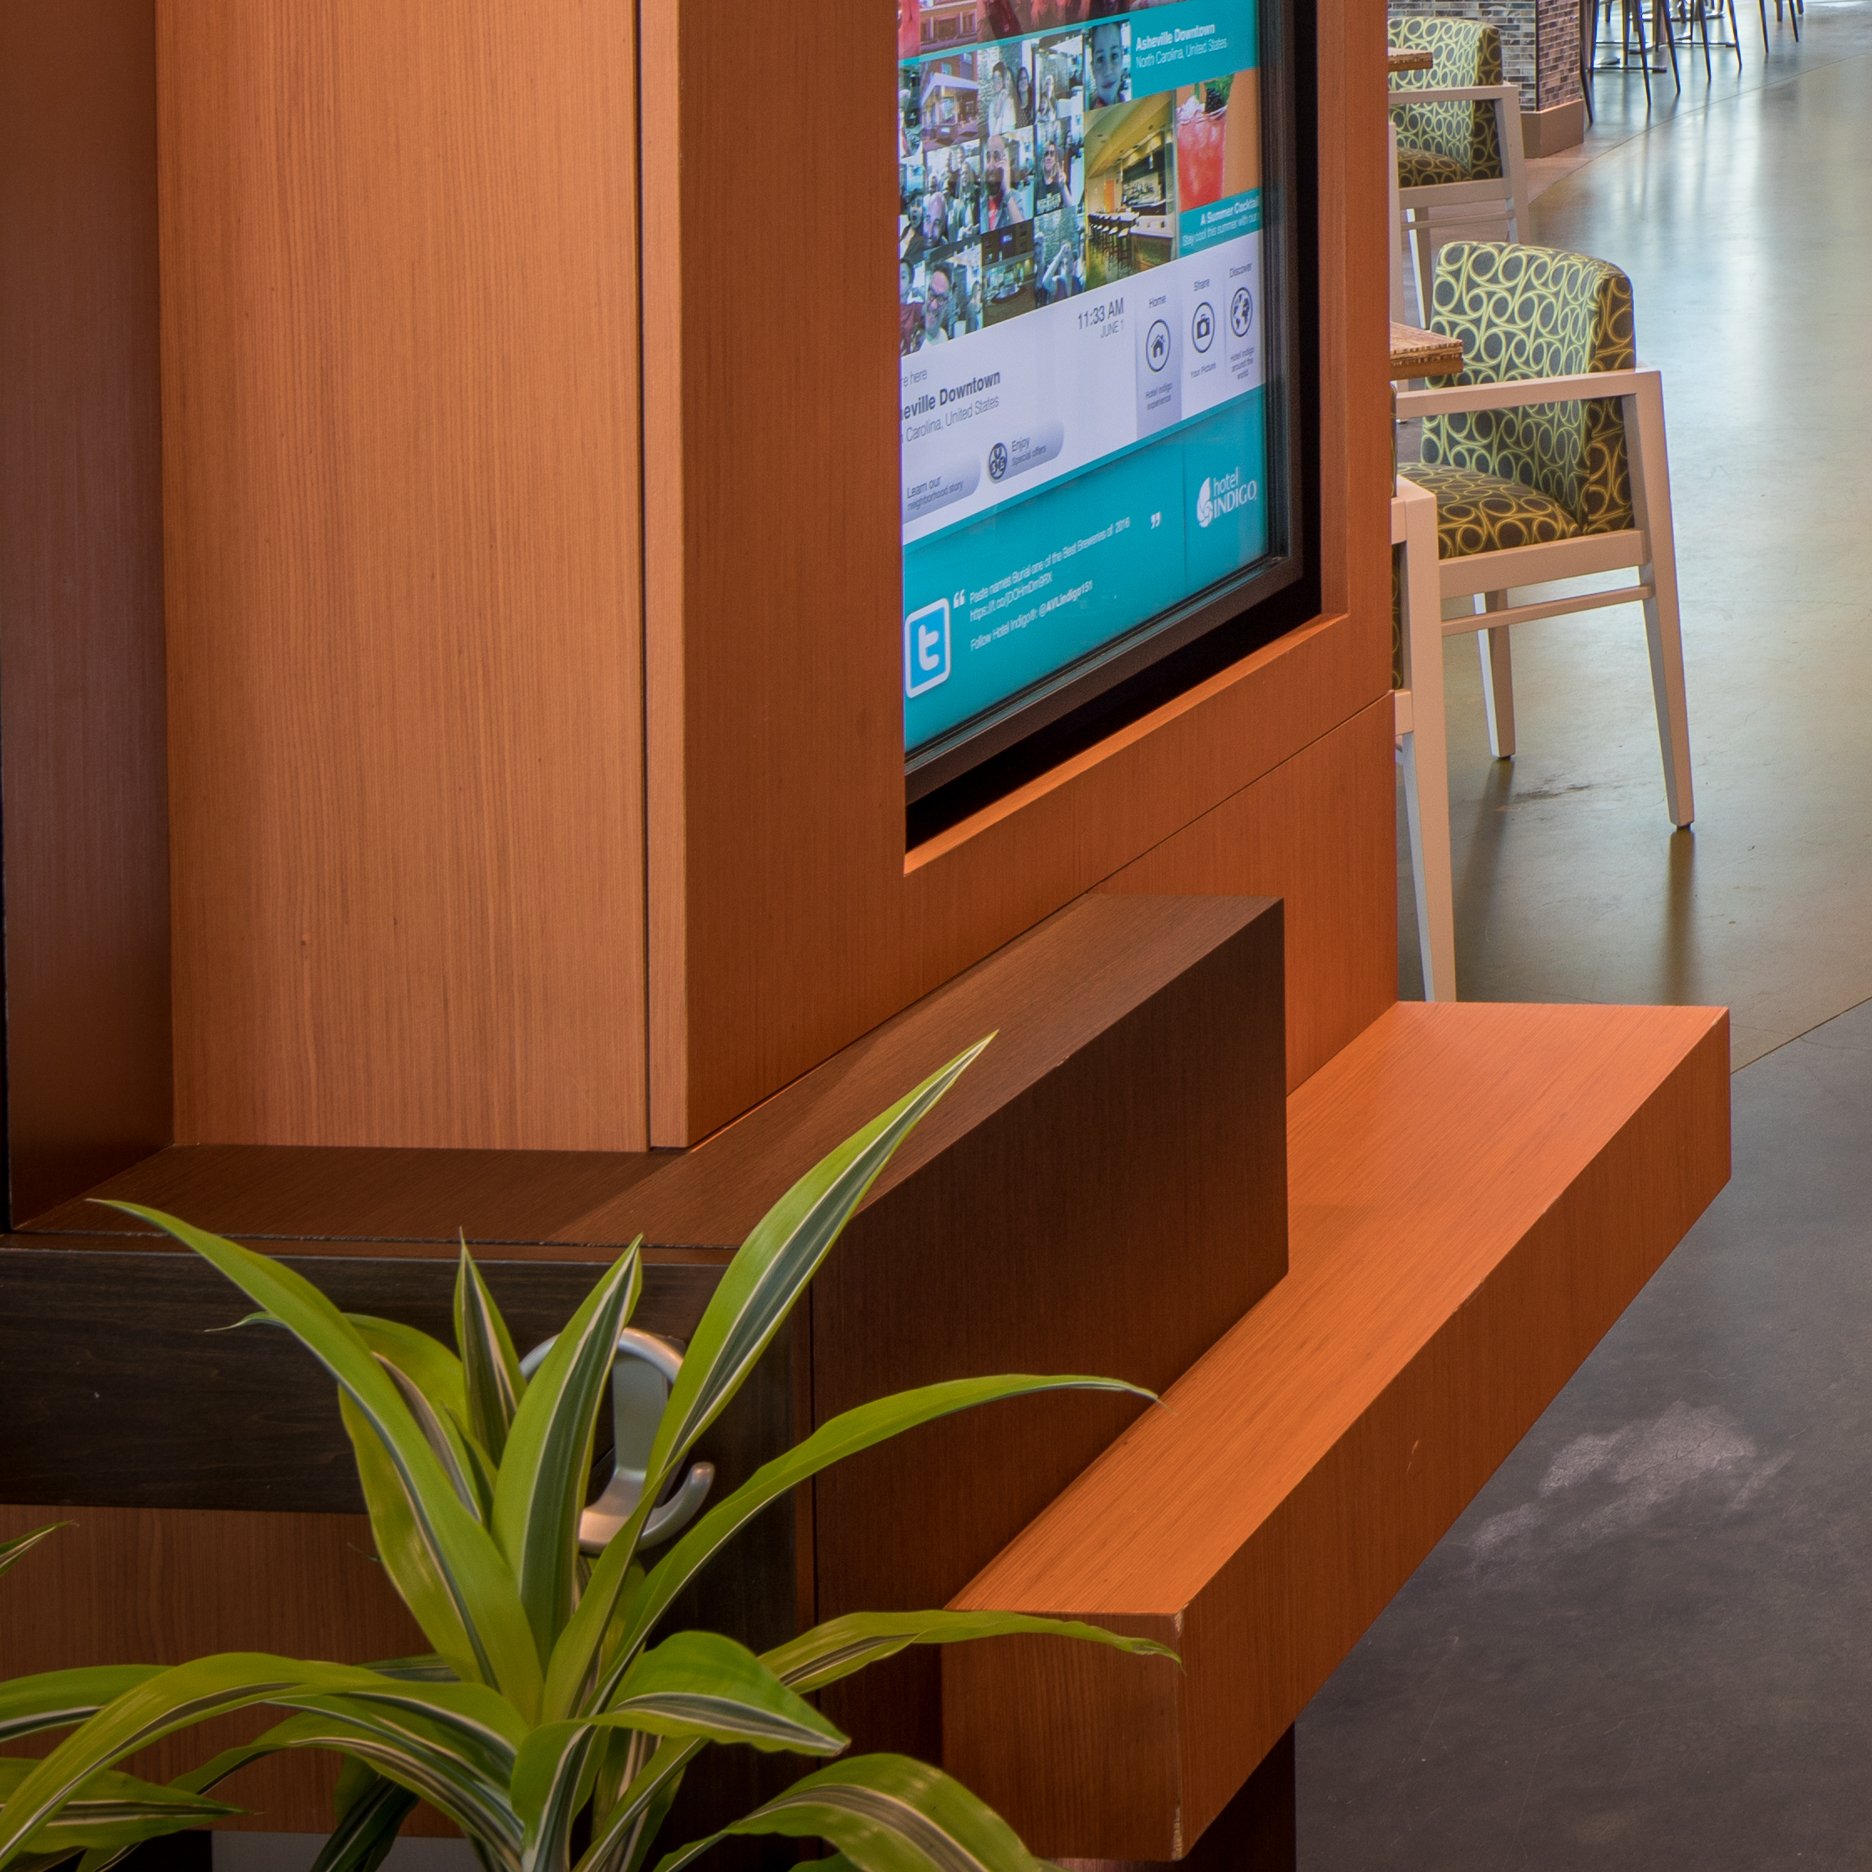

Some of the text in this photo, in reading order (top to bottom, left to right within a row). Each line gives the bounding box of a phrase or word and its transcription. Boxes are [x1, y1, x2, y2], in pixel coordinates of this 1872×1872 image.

[1136, 24, 1215, 52] Asheville Downtown
[1136, 52, 1155, 68] North
[1200, 213, 1206, 226] A
[1207, 207, 1234, 223] Summer
[1229, 263, 1252, 278] Discover
[1194, 279, 1210, 292] Share
[1148, 295, 1167, 309] Home
[1078, 297, 1124, 329] 11:33 AM
[1100, 321, 1119, 339] JUNE
[909, 369, 928, 385] here
[939, 371, 1001, 406] Downtown
[906, 395, 1000, 442] Carolina, United States
[1012, 437, 1031, 453] Enjoy
[906, 476, 942, 499] Learn our
[1213, 465, 1239, 497] hotel
[1213, 480, 1257, 519] INDIGO
